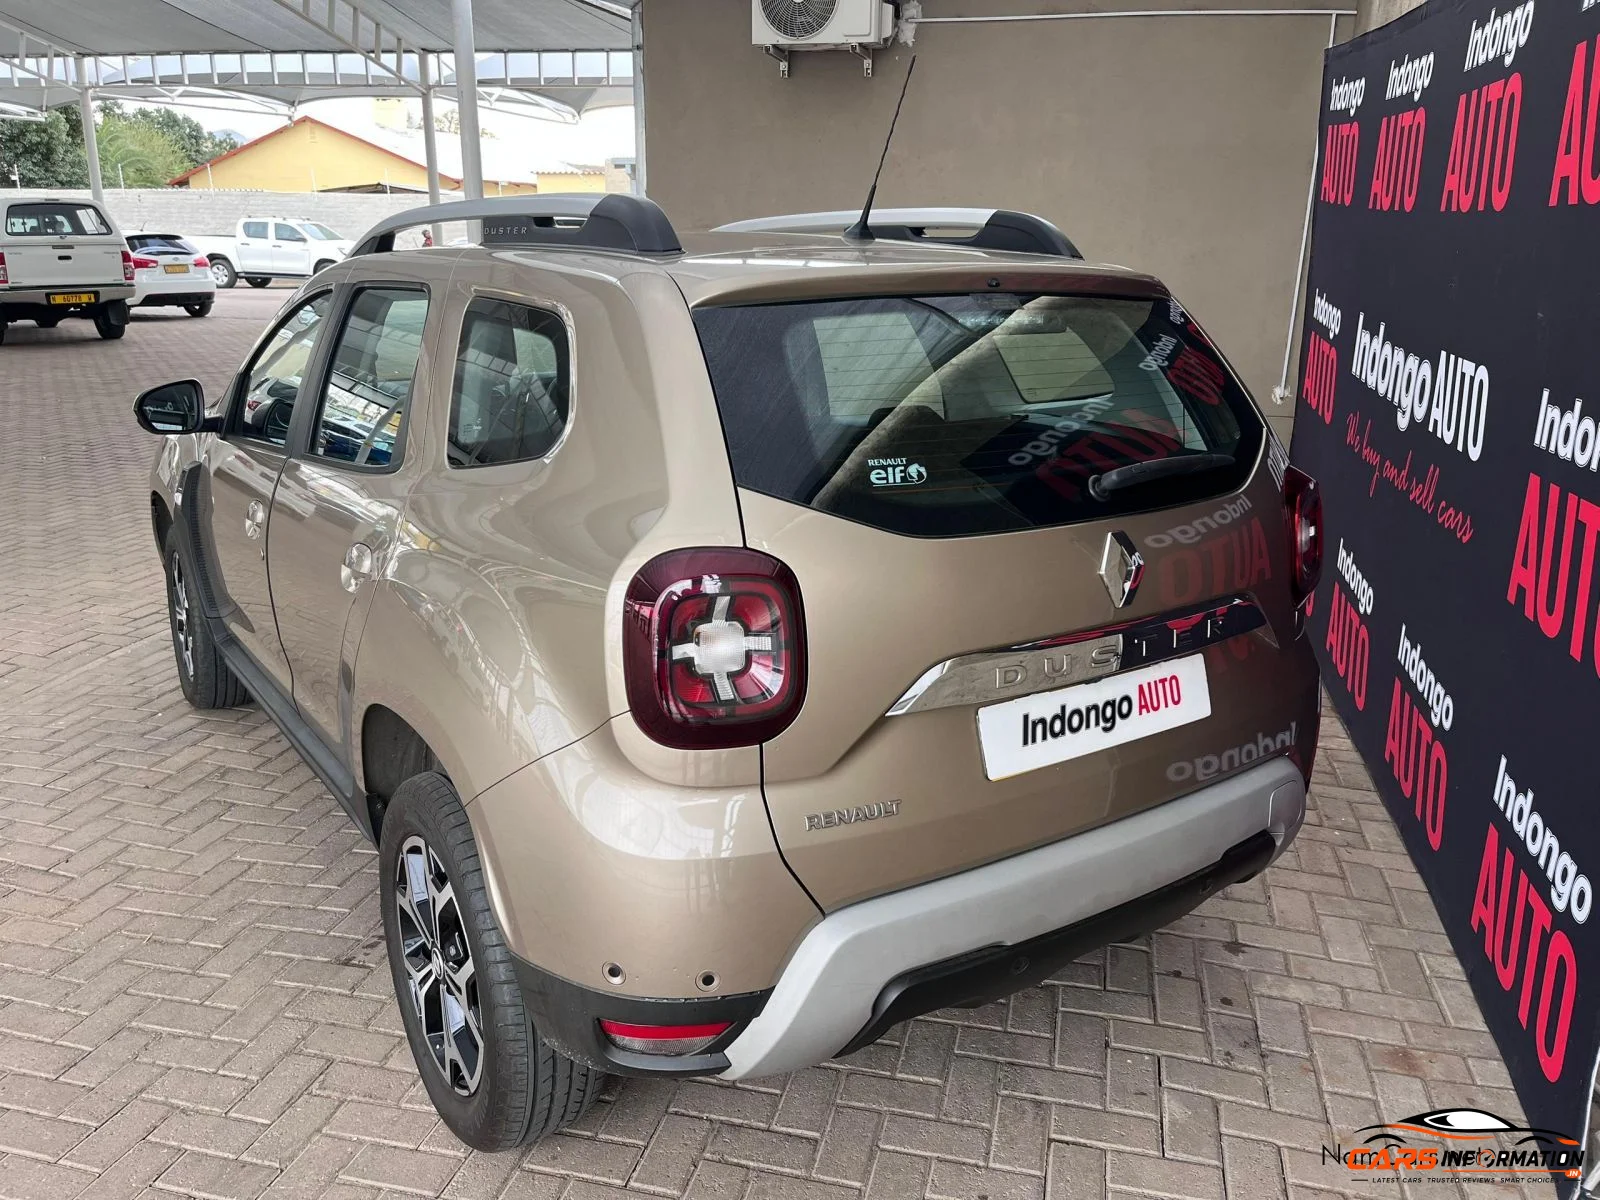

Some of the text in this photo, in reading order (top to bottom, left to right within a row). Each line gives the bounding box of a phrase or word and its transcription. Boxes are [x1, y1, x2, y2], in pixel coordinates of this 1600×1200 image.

[1385, 51, 1434, 102] Indongo
[1464, 0, 1535, 72] Indongo
[1329, 76, 1365, 117] Indongo
[1321, 121, 1360, 207] AUTO
[1368, 106, 1426, 213] AUTO
[1440, 72, 1522, 213] AUTO
[484, 226, 527, 235] DUSTER
[1313, 288, 1342, 340] Indongo
[1302, 331, 1337, 424] AUTO
[1351, 312, 1432, 431] Indongo
[1428, 350, 1489, 462] AUTO
[867, 457, 907, 467] RENAULT
[869, 466, 905, 484] elf
[1346, 411, 1474, 544] We buy and sell cars
[1337, 537, 1374, 616] Indongo
[1506, 471, 1600, 680] AUT
[995, 616, 1224, 690] DUSTER
[1326, 581, 1370, 711] AUTO
[1397, 622, 1453, 731] Indongo
[1022, 674, 1182, 748] Indongo AUTO
[1385, 675, 1448, 851] AUTO
[804, 799, 902, 832] RENAULT
[1492, 754, 1593, 924] Indongo
[1471, 821, 1577, 1083] AUTO
